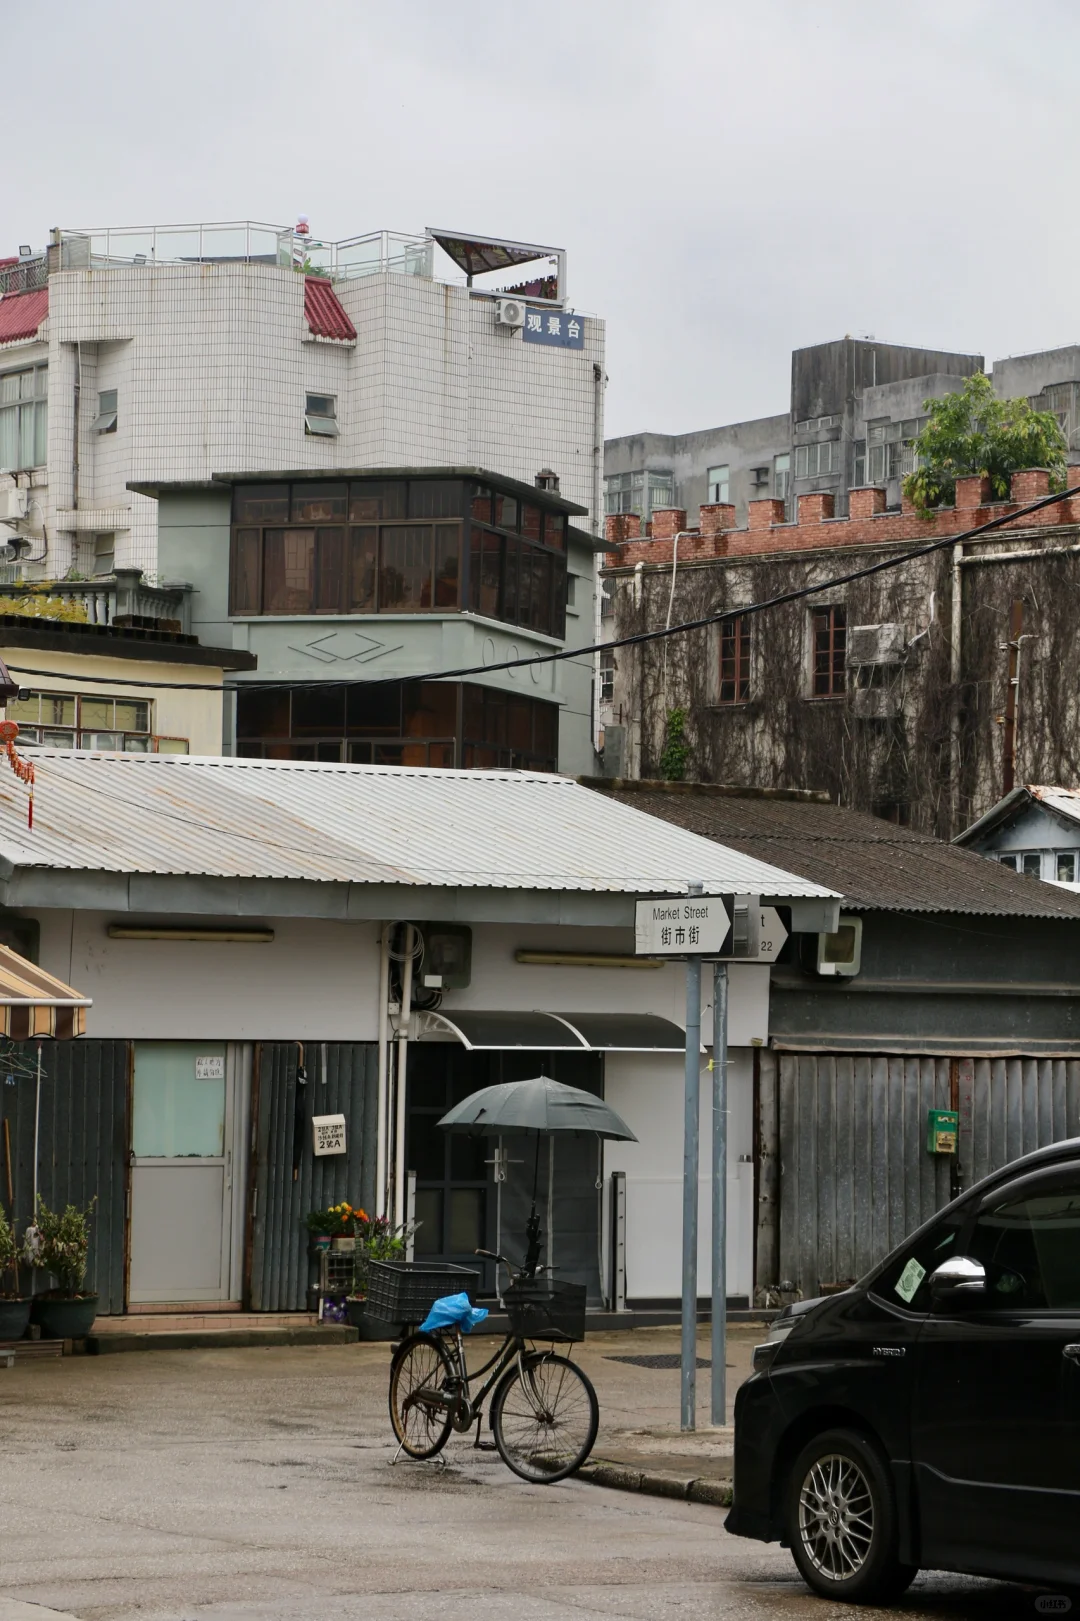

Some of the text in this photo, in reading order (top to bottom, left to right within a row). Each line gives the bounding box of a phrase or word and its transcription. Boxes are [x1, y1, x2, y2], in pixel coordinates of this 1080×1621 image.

[527, 314, 580, 339] 观景台
[652, 905, 709, 921] Market Street
[661, 926, 700, 946] 街市街
[319, 1139, 341, 1149] 2號A
